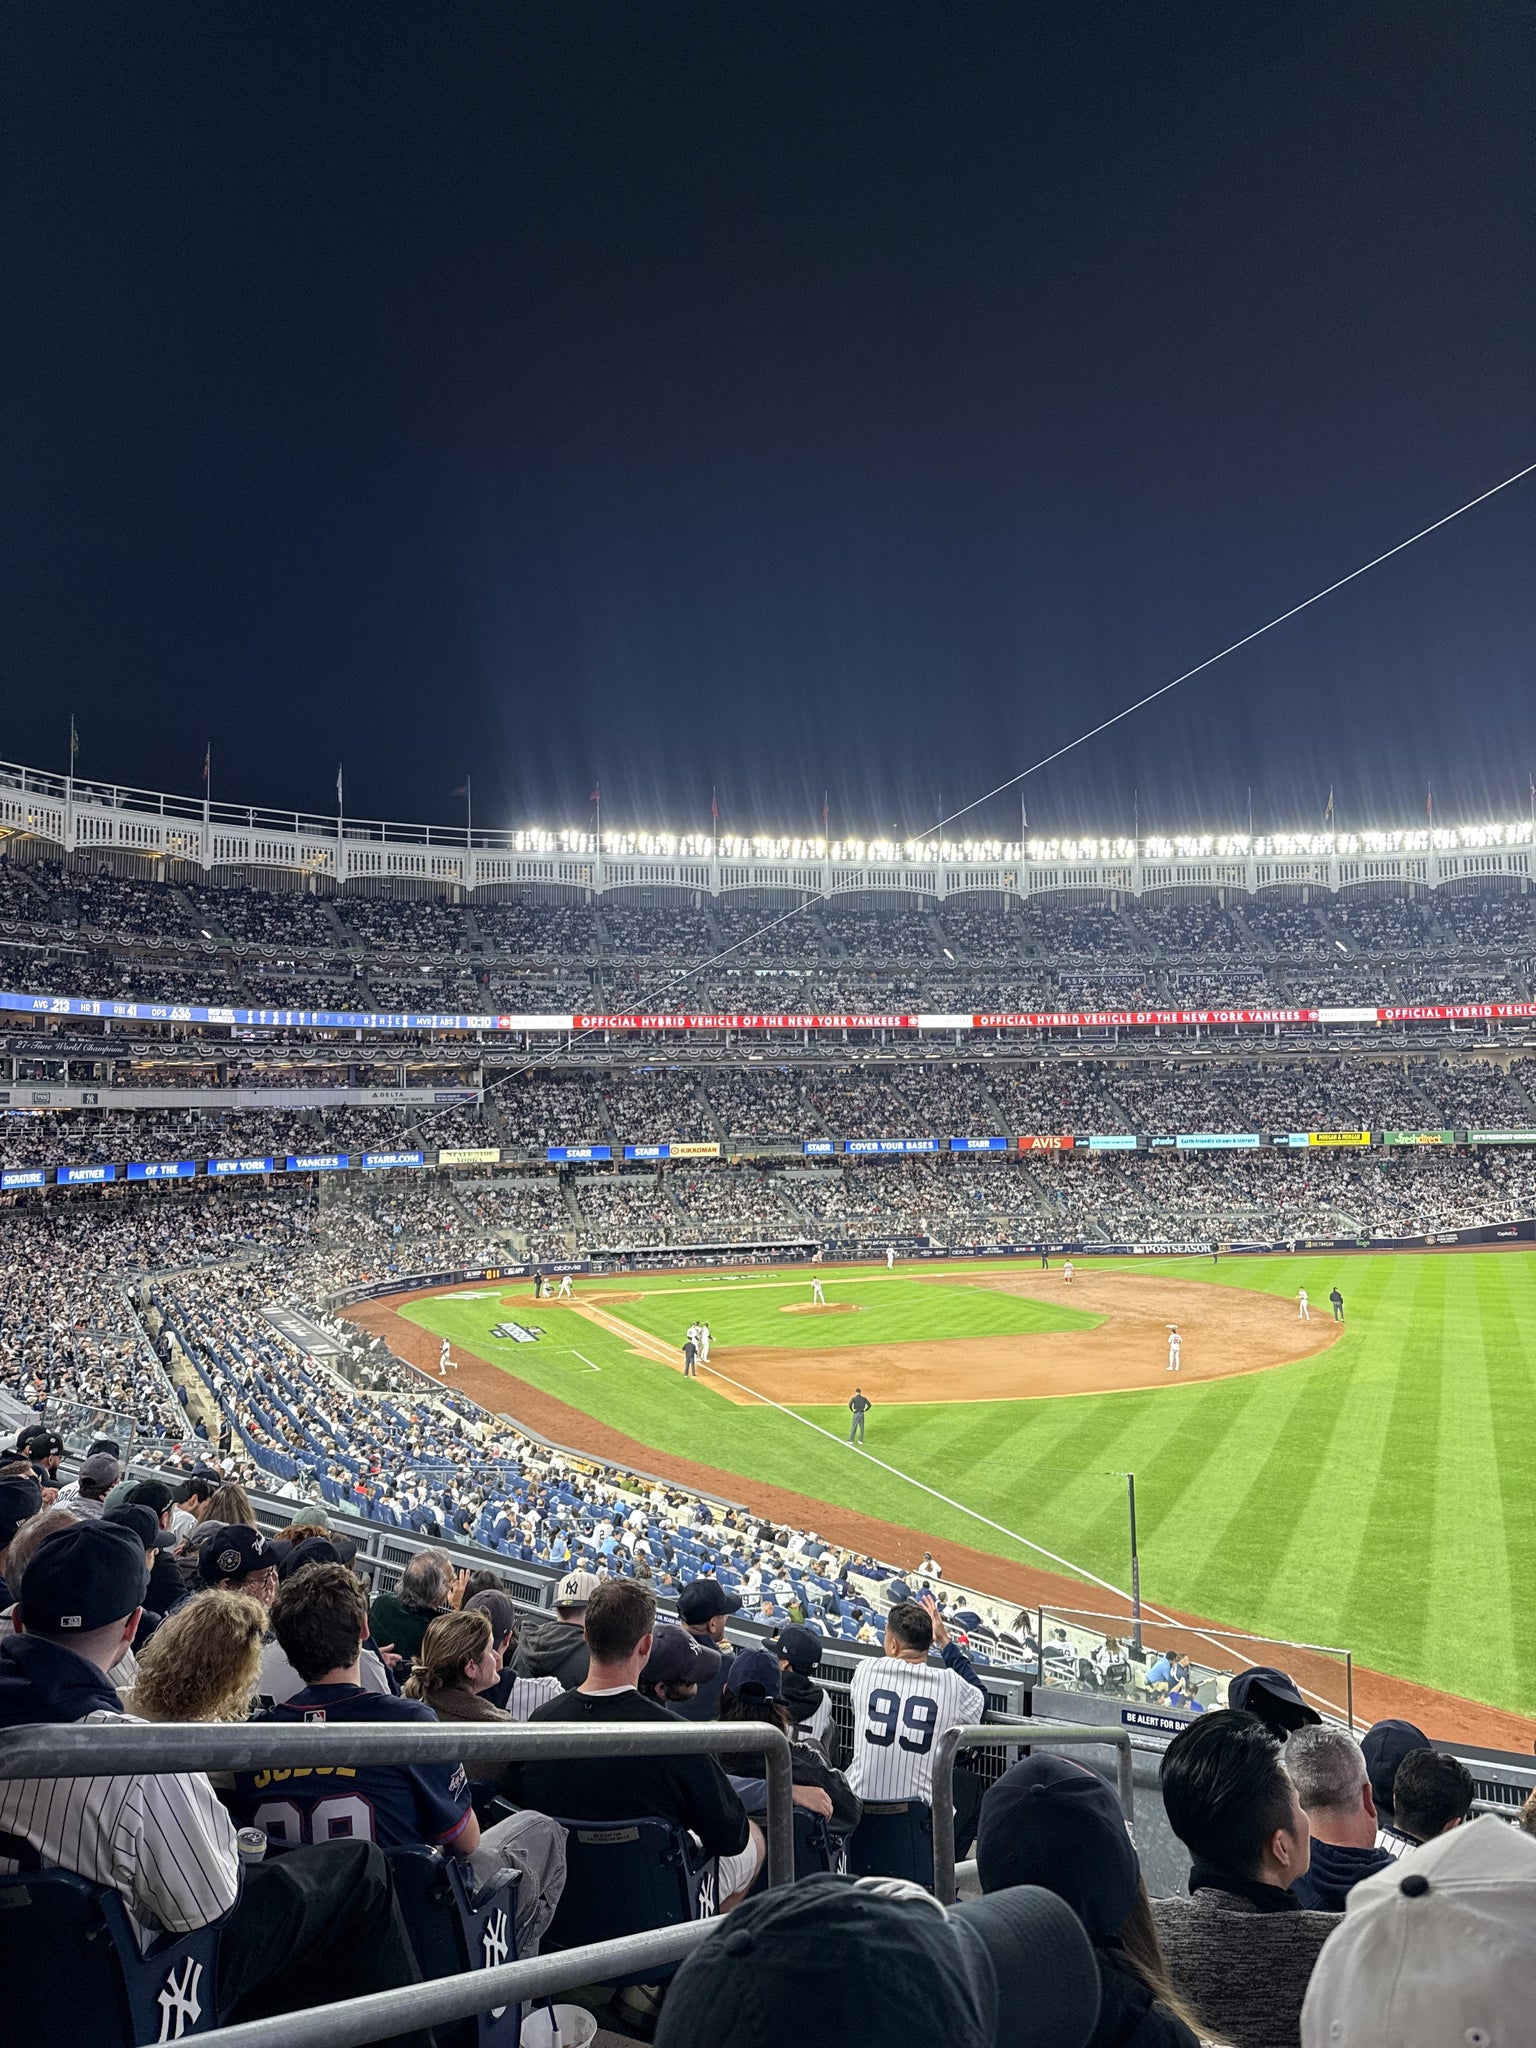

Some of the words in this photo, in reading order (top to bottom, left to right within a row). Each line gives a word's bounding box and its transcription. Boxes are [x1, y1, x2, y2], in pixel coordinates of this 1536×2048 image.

[1108, 977, 1140, 985] VODKA
[32, 1000, 48, 1010] AVG
[50, 1000, 70, 1012] .213
[80, 1004, 90, 1012] HR
[92, 1002, 100, 1014] 11
[114, 1006, 125, 1014] RBI
[126, 1006, 137, 1017] 41
[152, 1008, 166, 1017] OPS
[169, 1008, 191, 1020] .636
[1386, 1008, 1440, 1018] OFFICIAL
[1446, 1007, 1492, 1016] HYBRID
[466, 1016, 492, 1028] 10:10
[581, 1017, 636, 1026] OFFICIAL
[642, 1017, 686, 1026] HYBRID
[690, 1016, 738, 1026] VEHICLE
[743, 1016, 758, 1026] OF
[763, 1016, 784, 1026] THE
[788, 1016, 814, 1026] NEW
[818, 1016, 847, 1025] YORK
[852, 1016, 900, 1025] YANKEES
[980, 1016, 1033, 1025] OFFICIAL
[1038, 1015, 1080, 1024] HYBRID
[1084, 1014, 1132, 1024] VEHICLE
[1137, 1014, 1152, 1022] OF
[1158, 1014, 1178, 1022] THE
[1182, 1013, 1208, 1022] NEW
[1213, 1012, 1244, 1022] YORK
[1248, 1012, 1300, 1021] YANKEES
[16, 1041, 52, 1051] 27-Time
[56, 1042, 80, 1052] World
[83, 1044, 124, 1054] Champions
[1032, 1138, 1059, 1148] AVIS
[1395, 1132, 1443, 1144] freshdirect
[635, 1148, 660, 1156] STARR
[808, 1144, 830, 1152] STARR
[366, 1154, 418, 1165] STARR.COM
[566, 1150, 592, 1158] STARR
[216, 1162, 236, 1172] NEW
[240, 1160, 265, 1170] YORK
[296, 1158, 338, 1168] YANKEES
[68, 1170, 105, 1180] PARTNER
[145, 1166, 158, 1176] OF
[161, 1165, 178, 1175] THE
[4, 1174, 42, 1185] SIGNATURE
[1146, 1244, 1211, 1253] POSTSEASON
[566, 1580, 578, 1595] NY
[1108, 1654, 1120, 1664] 13
[865, 1688, 939, 1756] 99
[1126, 1712, 1136, 1723] BE
[1138, 1714, 1159, 1727] ALERT
[1160, 1718, 1174, 1730] FOR
[482, 1908, 508, 1969] NY
[158, 1955, 203, 2044] NY
